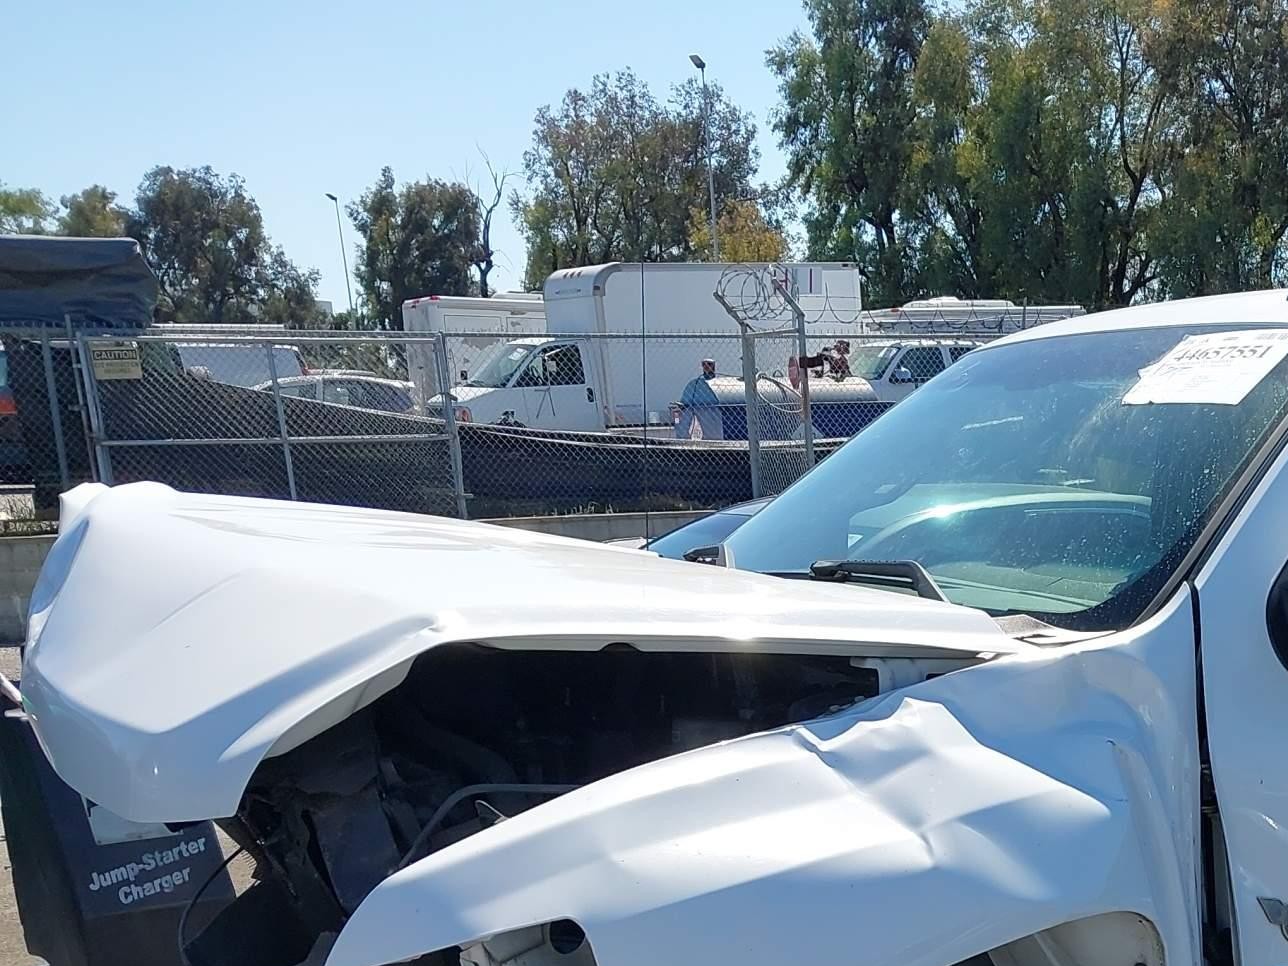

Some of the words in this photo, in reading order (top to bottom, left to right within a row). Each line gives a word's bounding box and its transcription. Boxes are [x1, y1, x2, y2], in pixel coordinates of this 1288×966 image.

[93, 350, 137, 360] CAUTION
[1174, 345, 1273, 361] 44657551
[88, 838, 206, 891] Jump-Starter
[118, 867, 191, 905] Charger
